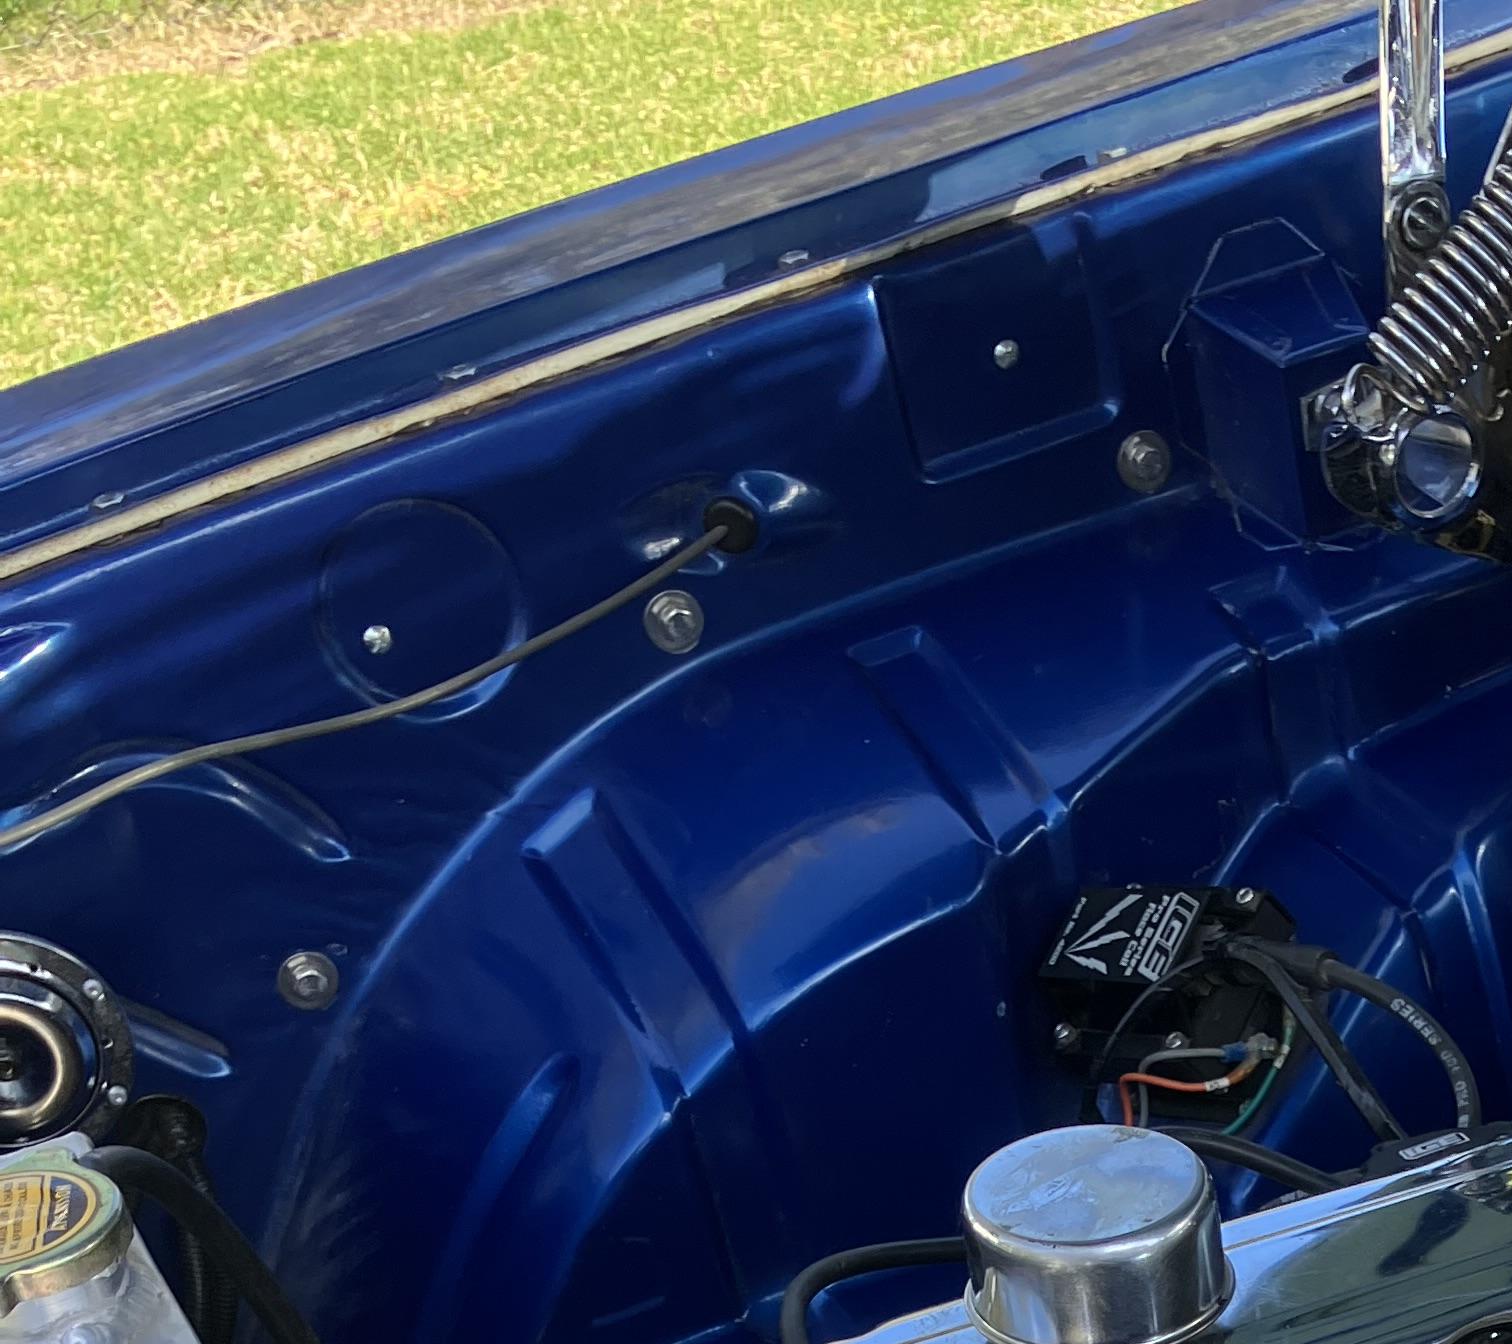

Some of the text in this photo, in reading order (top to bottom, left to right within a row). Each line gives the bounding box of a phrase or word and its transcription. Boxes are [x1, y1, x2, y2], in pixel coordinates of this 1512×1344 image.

[1124, 895, 1171, 976] Pro Series
[1135, 902, 1157, 937] Race
